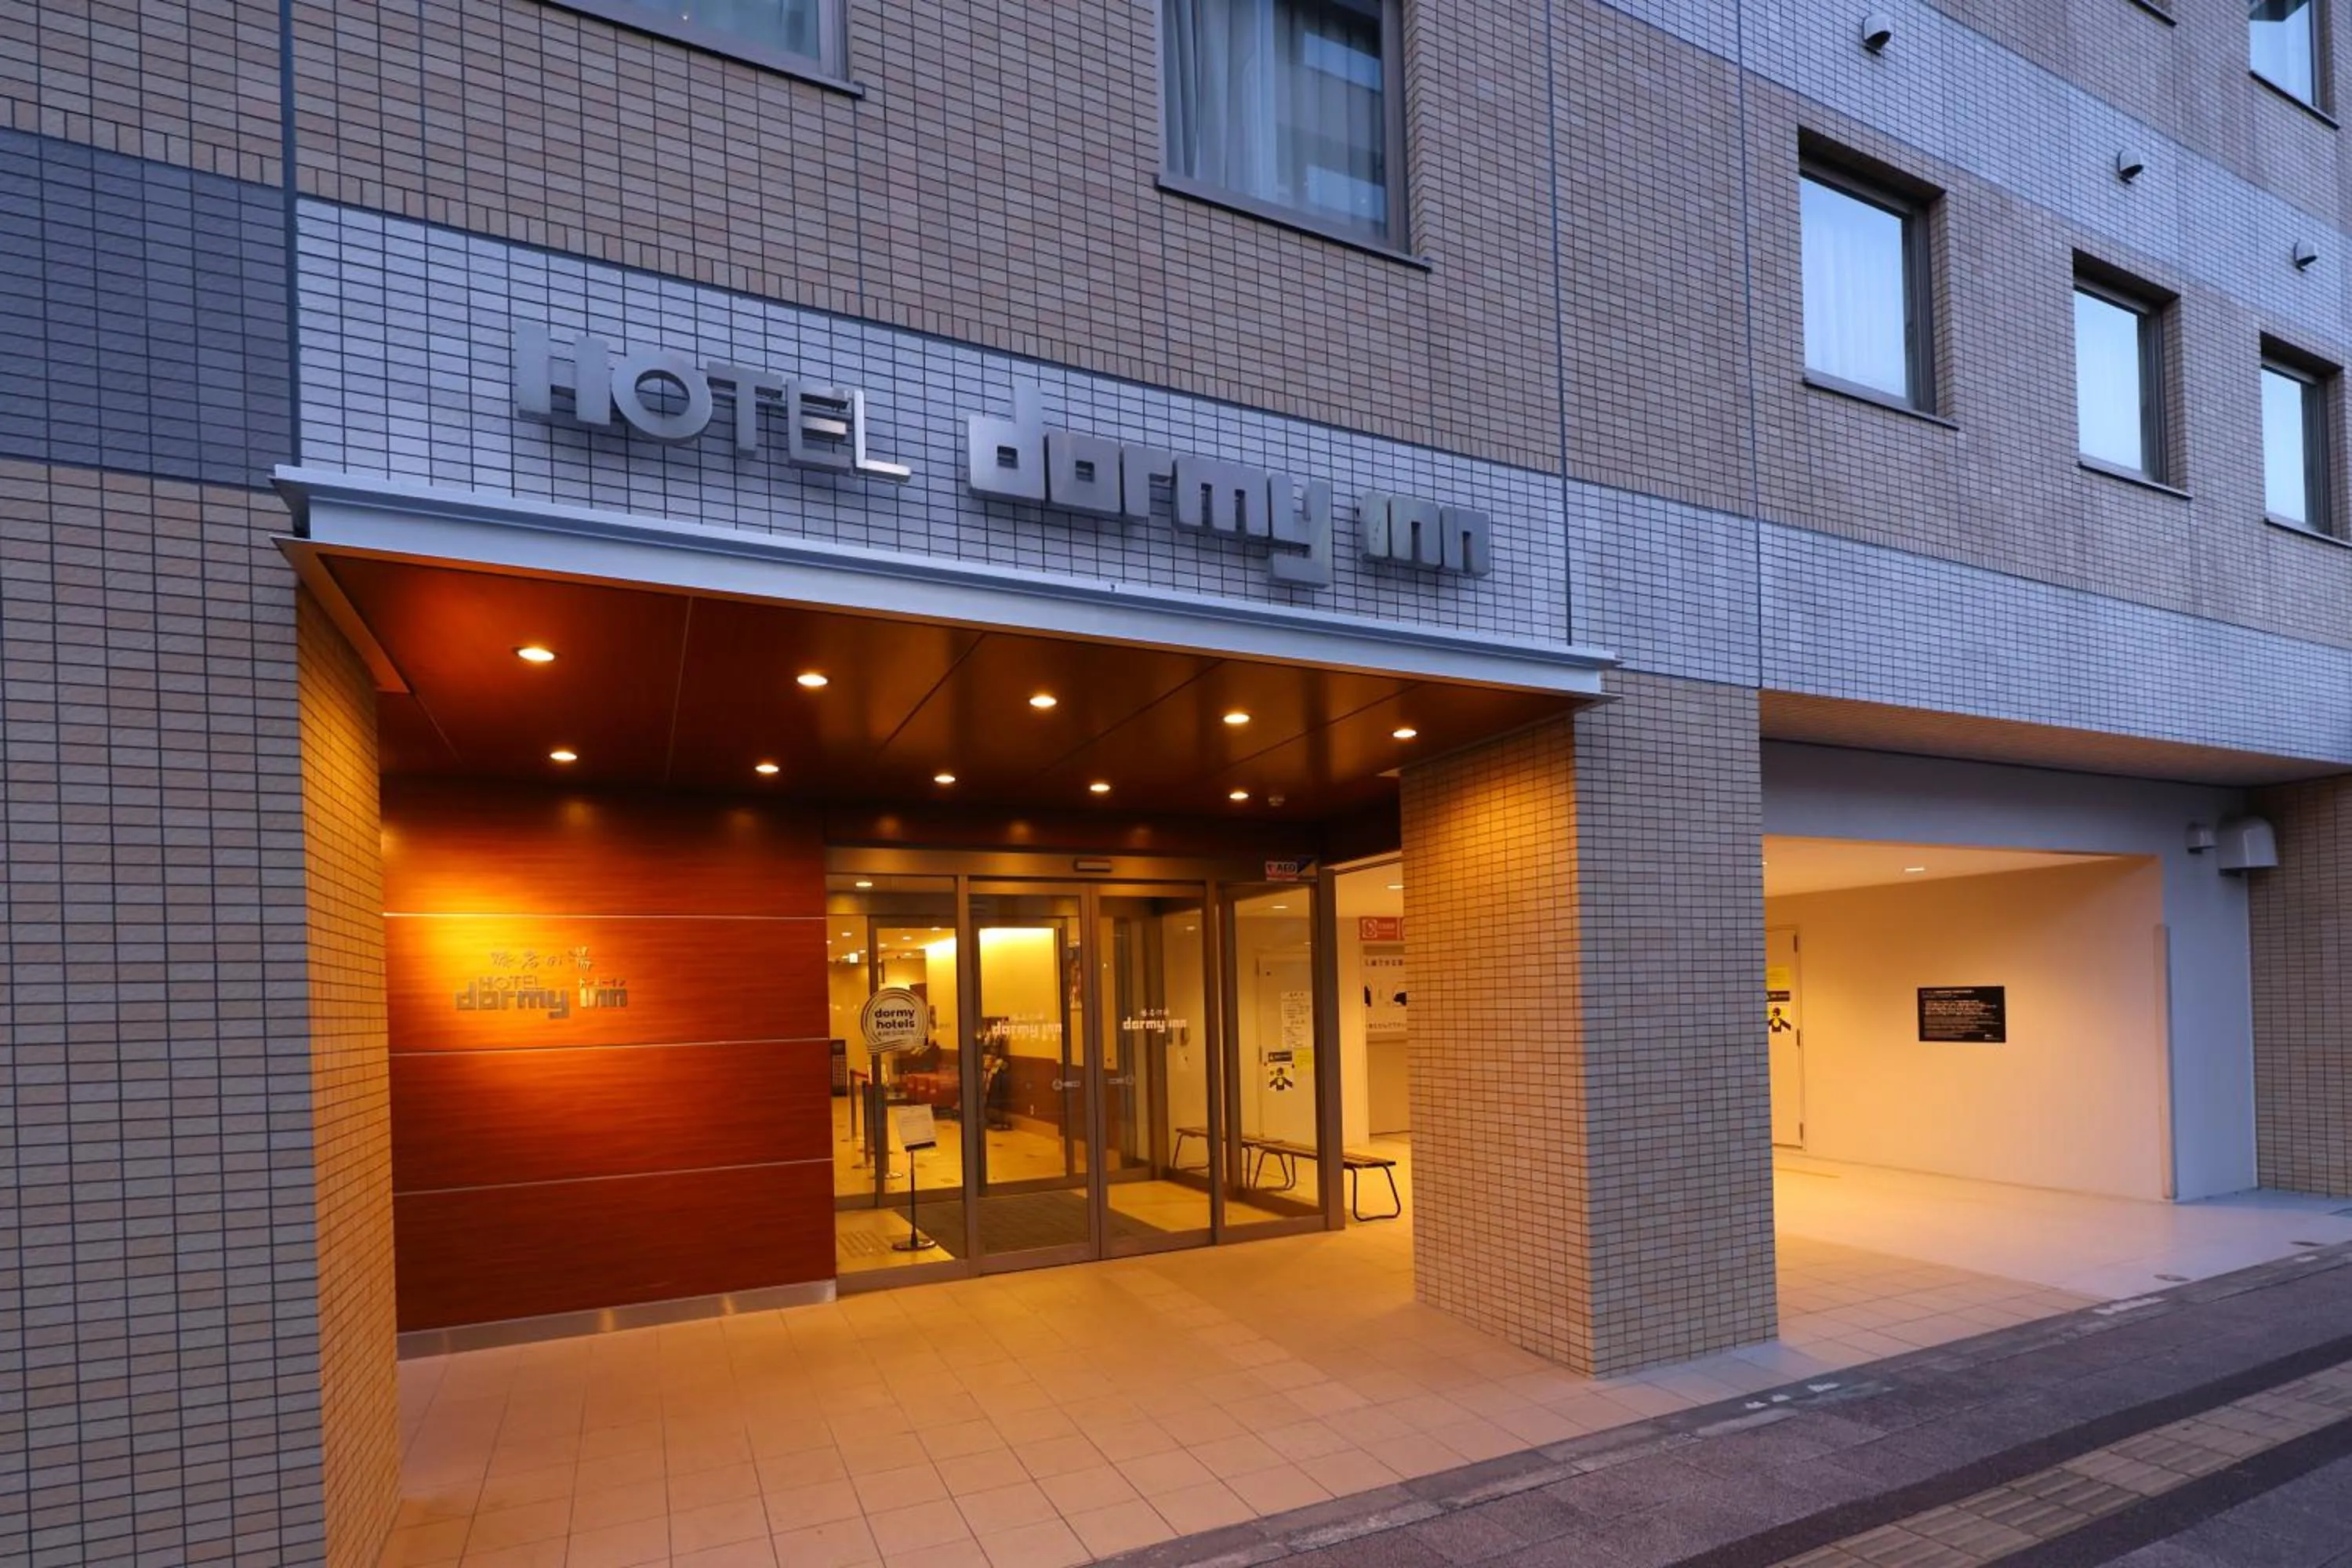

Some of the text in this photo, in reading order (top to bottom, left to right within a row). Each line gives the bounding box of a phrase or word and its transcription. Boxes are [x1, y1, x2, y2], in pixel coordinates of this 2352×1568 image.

[514, 320, 1490, 589] HOTEL dormy inn
[478, 975, 546, 990] HOTEL
[456, 982, 628, 1018] dormy inn
[874, 1008, 915, 1019] dormy
[876, 1019, 915, 1029] hotels
[992, 1021, 1039, 1039] dormy
[1123, 1016, 1166, 1033] dormy
